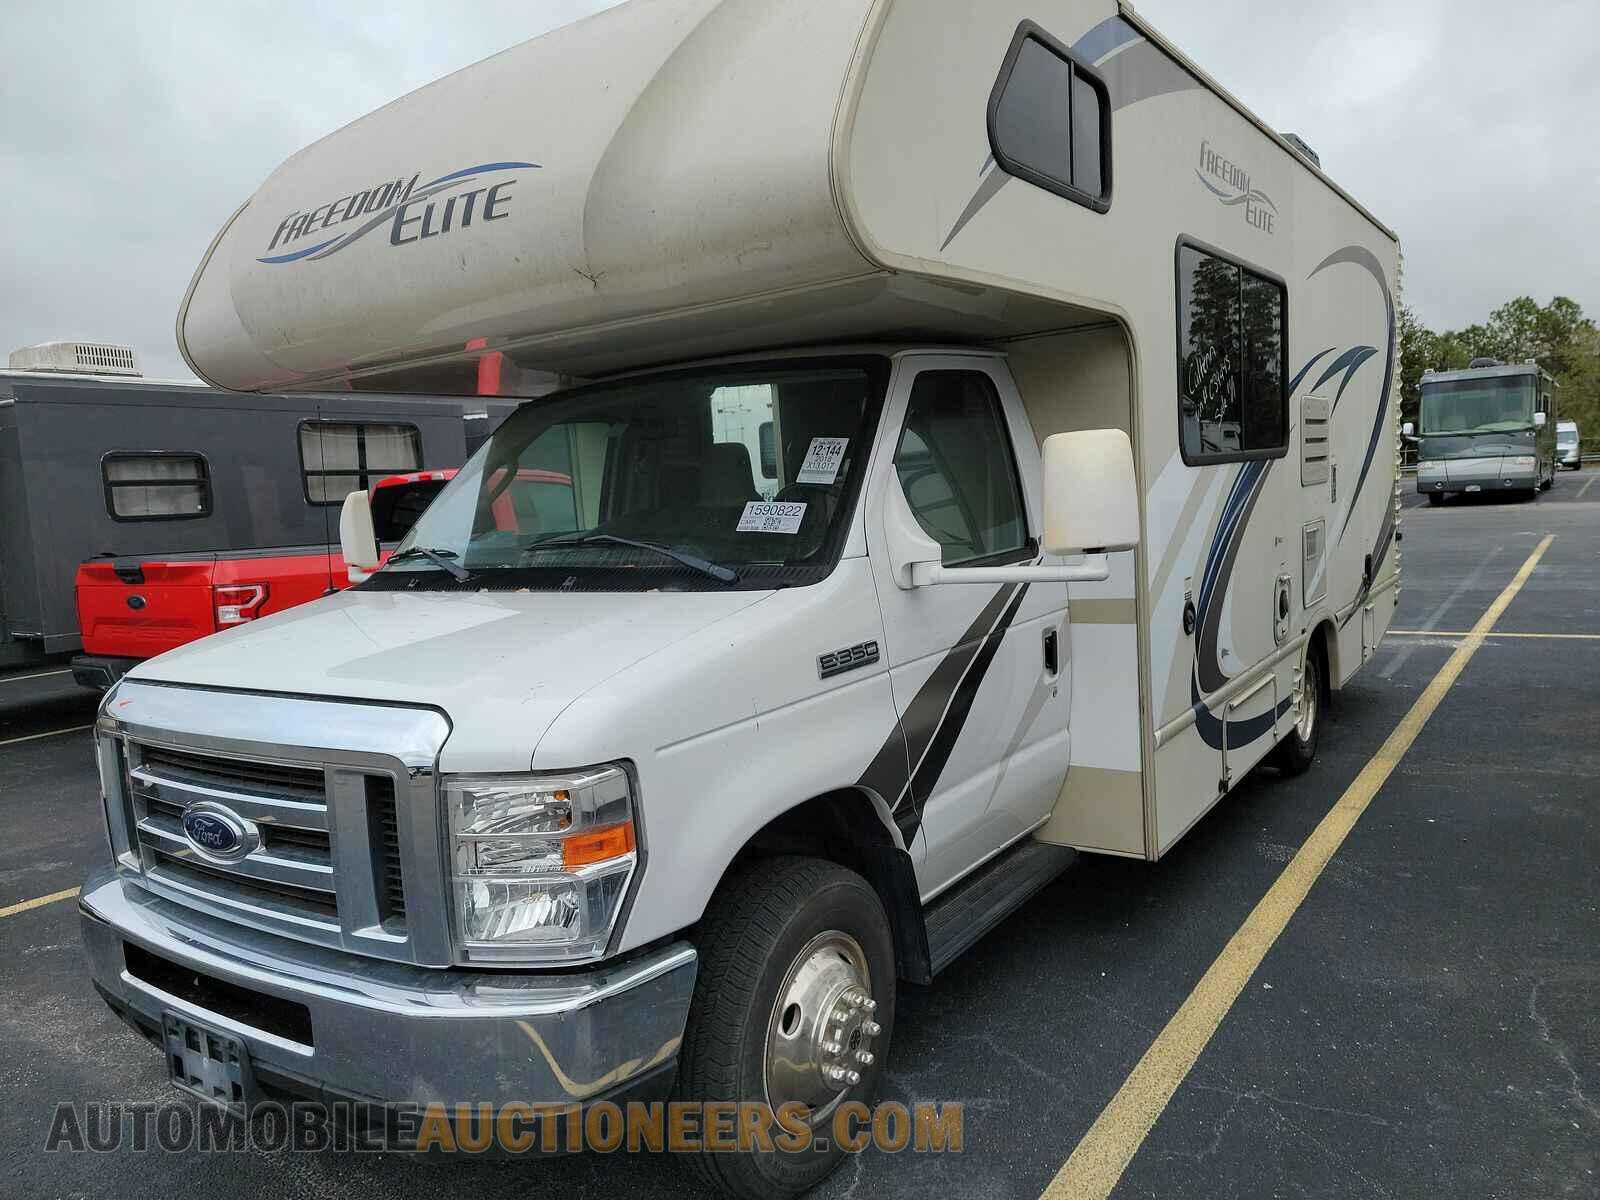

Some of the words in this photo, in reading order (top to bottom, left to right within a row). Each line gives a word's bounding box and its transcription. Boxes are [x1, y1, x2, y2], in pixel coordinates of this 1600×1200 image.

[1199, 139, 1251, 195] FREEDOM
[266, 170, 423, 252] FREEDOM
[389, 179, 518, 247] ELITE
[1245, 196, 1275, 235] ELITE
[811, 444, 842, 457] 12:144
[748, 504, 802, 517] 1590822
[191, 818, 223, 847] Ford
